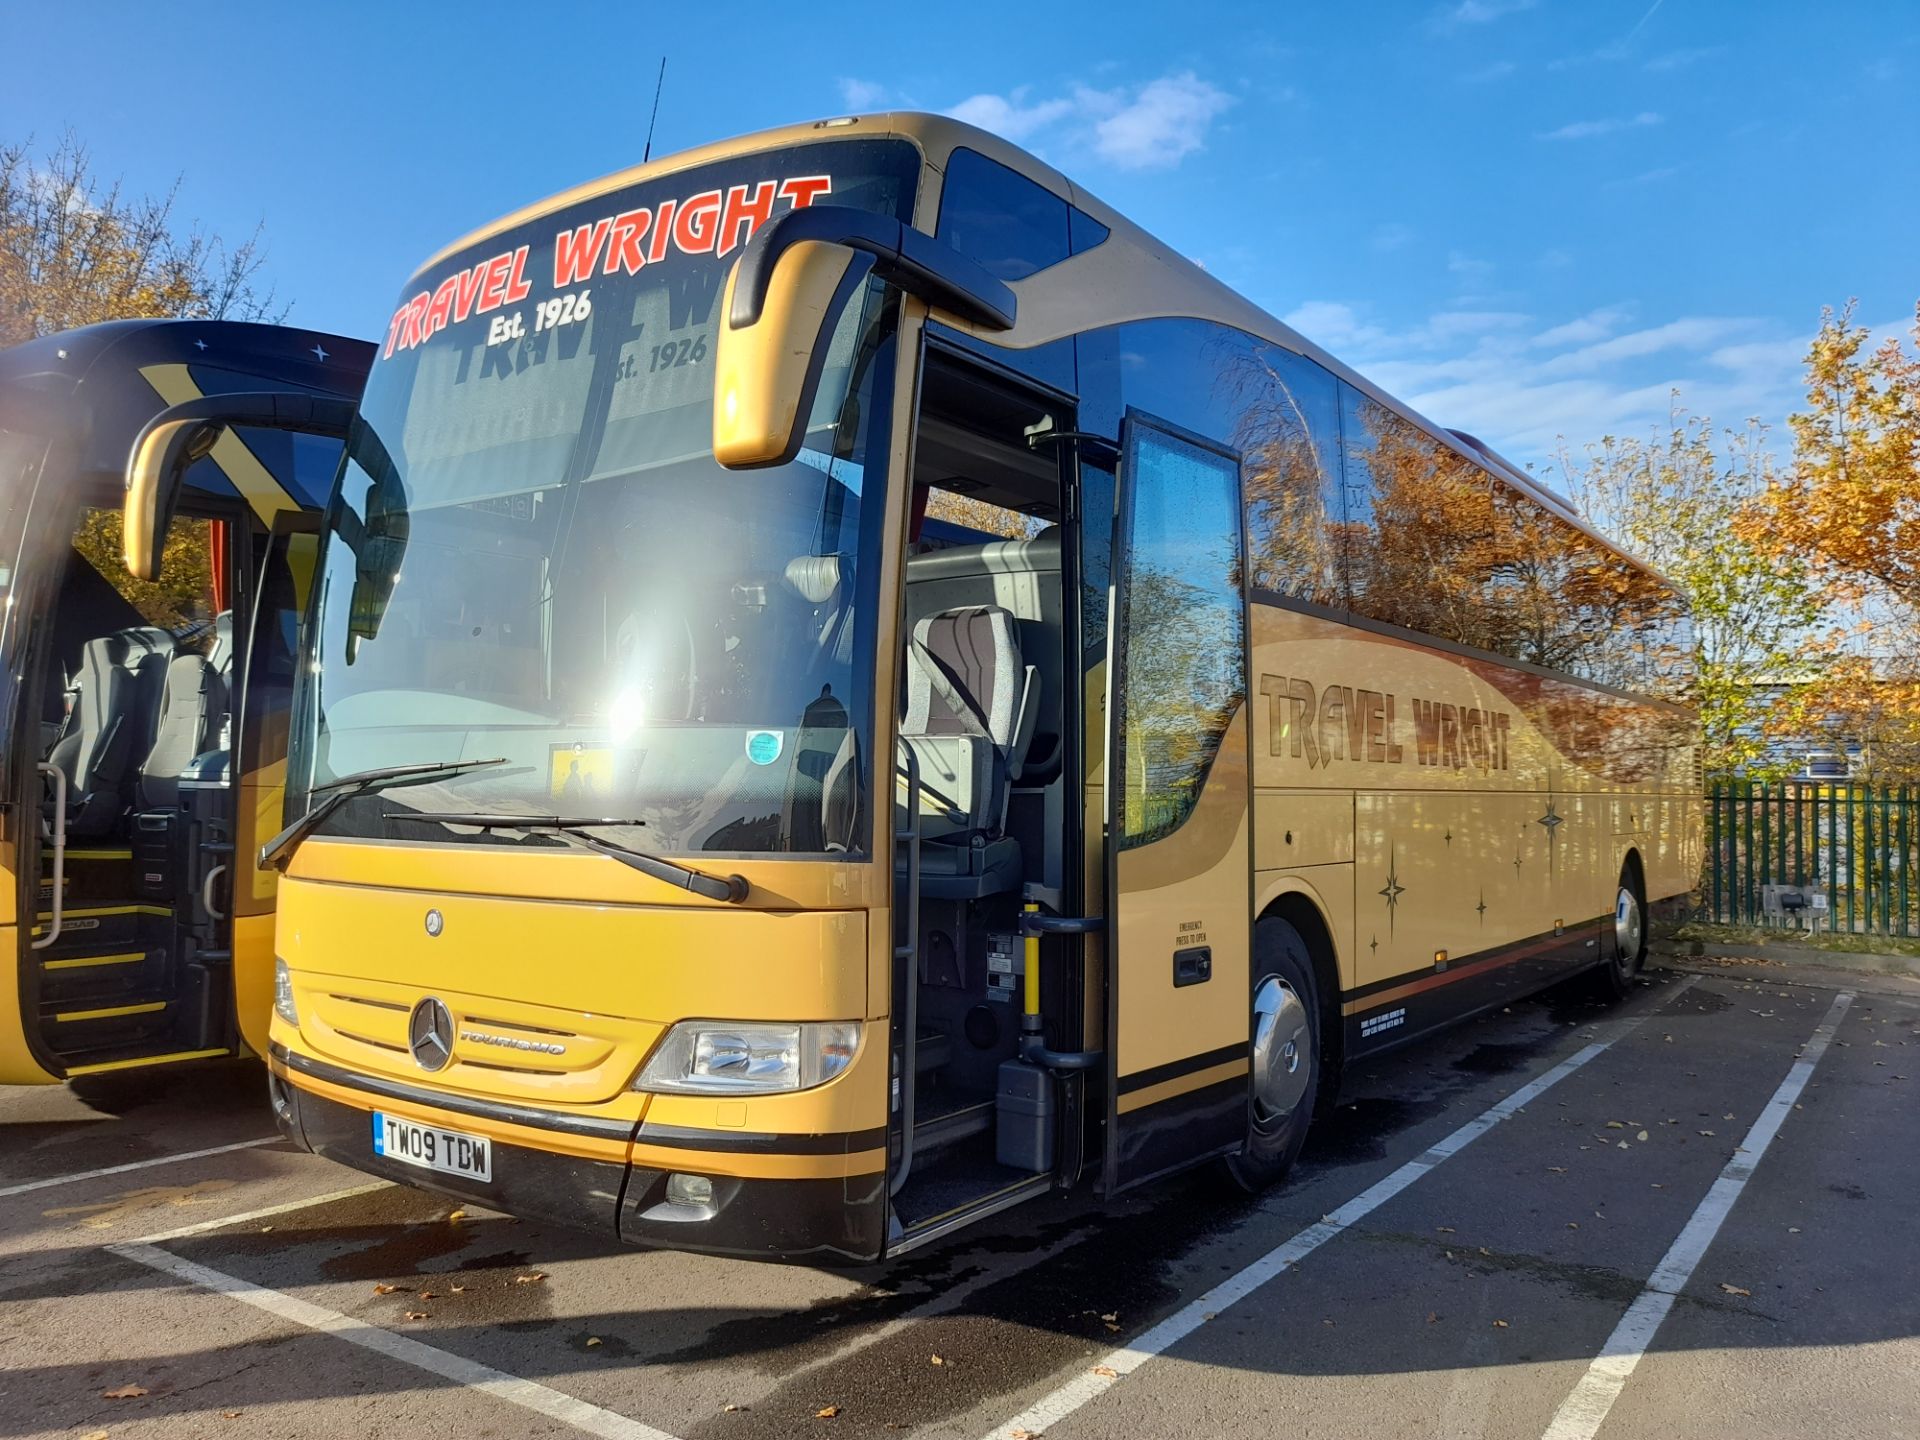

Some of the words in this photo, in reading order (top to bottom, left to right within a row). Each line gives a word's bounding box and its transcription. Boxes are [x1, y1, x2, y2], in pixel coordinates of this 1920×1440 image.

[383, 244, 532, 361] TRAVEL
[554, 175, 832, 289] WRIGHT
[487, 311, 526, 346] Est.
[535, 290, 592, 332] 1926
[650, 334, 708, 374] 1926
[1260, 672, 1403, 770] TRAVEL
[1412, 698, 1511, 777] WRIGHT
[1176, 935, 1189, 946] PRESS
[1196, 932, 1206, 943] OPEN
[1179, 921, 1202, 932] EMERGENCY
[460, 1031, 566, 1055] TOURISMO
[387, 1120, 436, 1163] TW09
[442, 1134, 486, 1175] TDW
